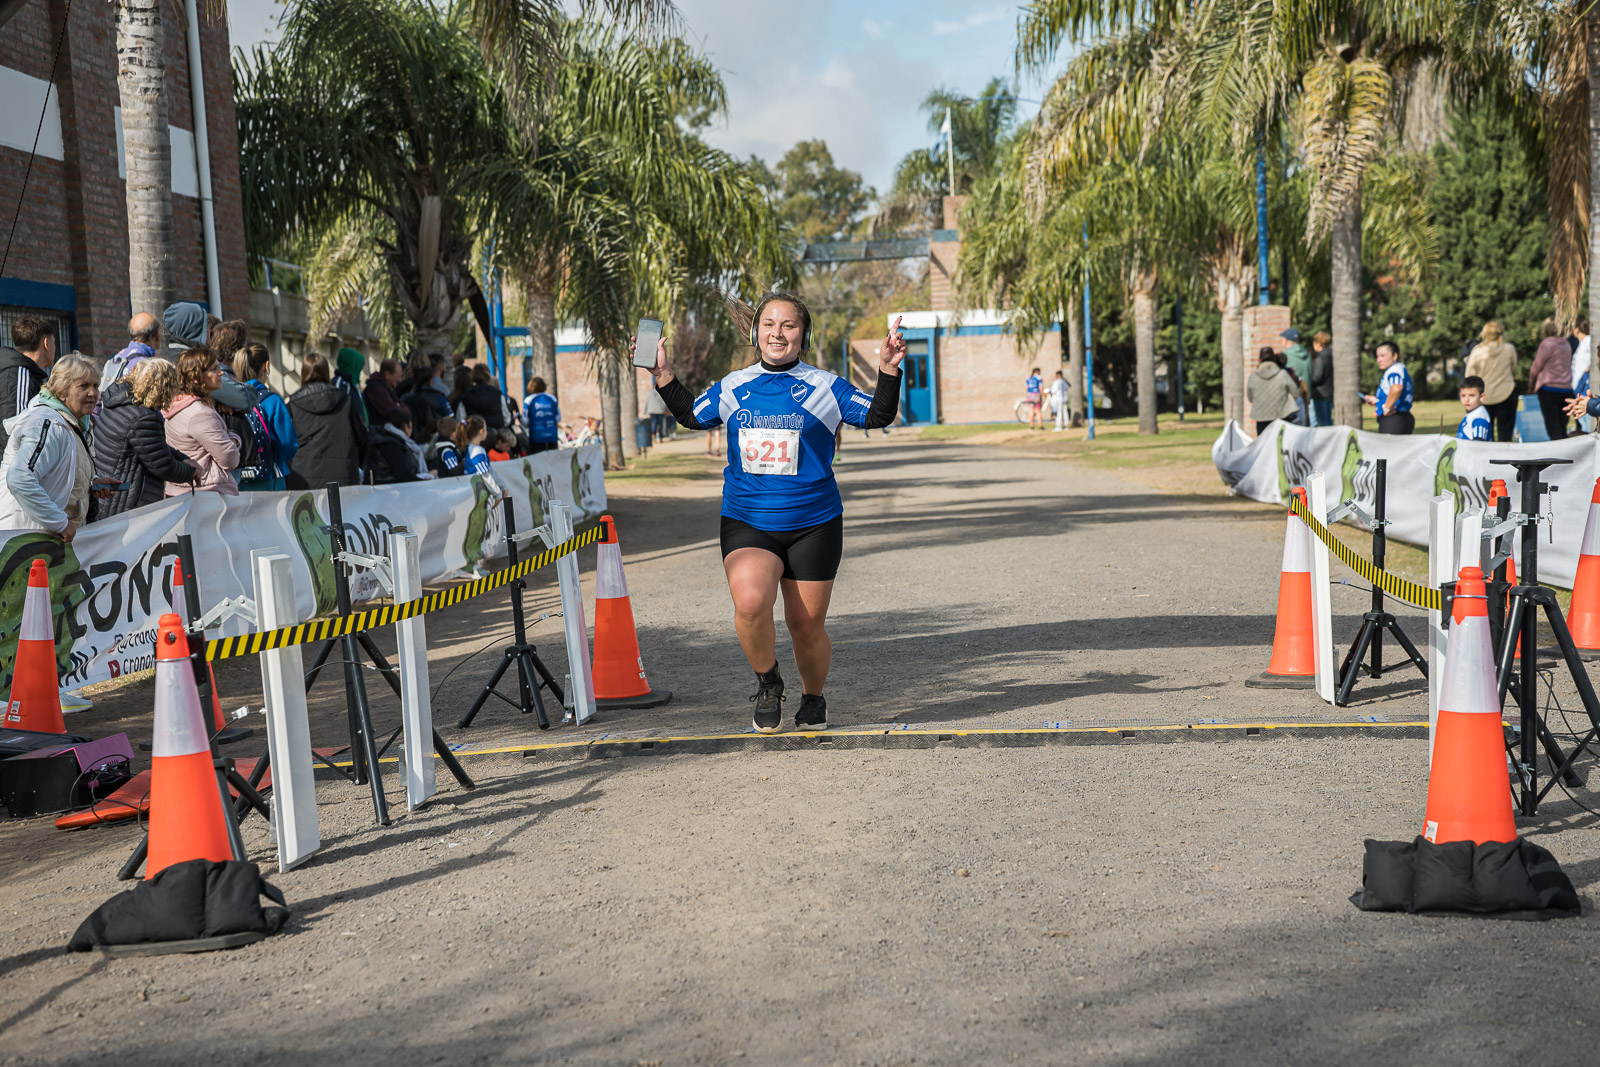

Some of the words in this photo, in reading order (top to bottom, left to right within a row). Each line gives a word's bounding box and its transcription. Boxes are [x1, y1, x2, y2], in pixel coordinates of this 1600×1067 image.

[754, 413, 804, 429] MARATÓN
[746, 441, 790, 462] 521
[124, 654, 155, 674] crono
